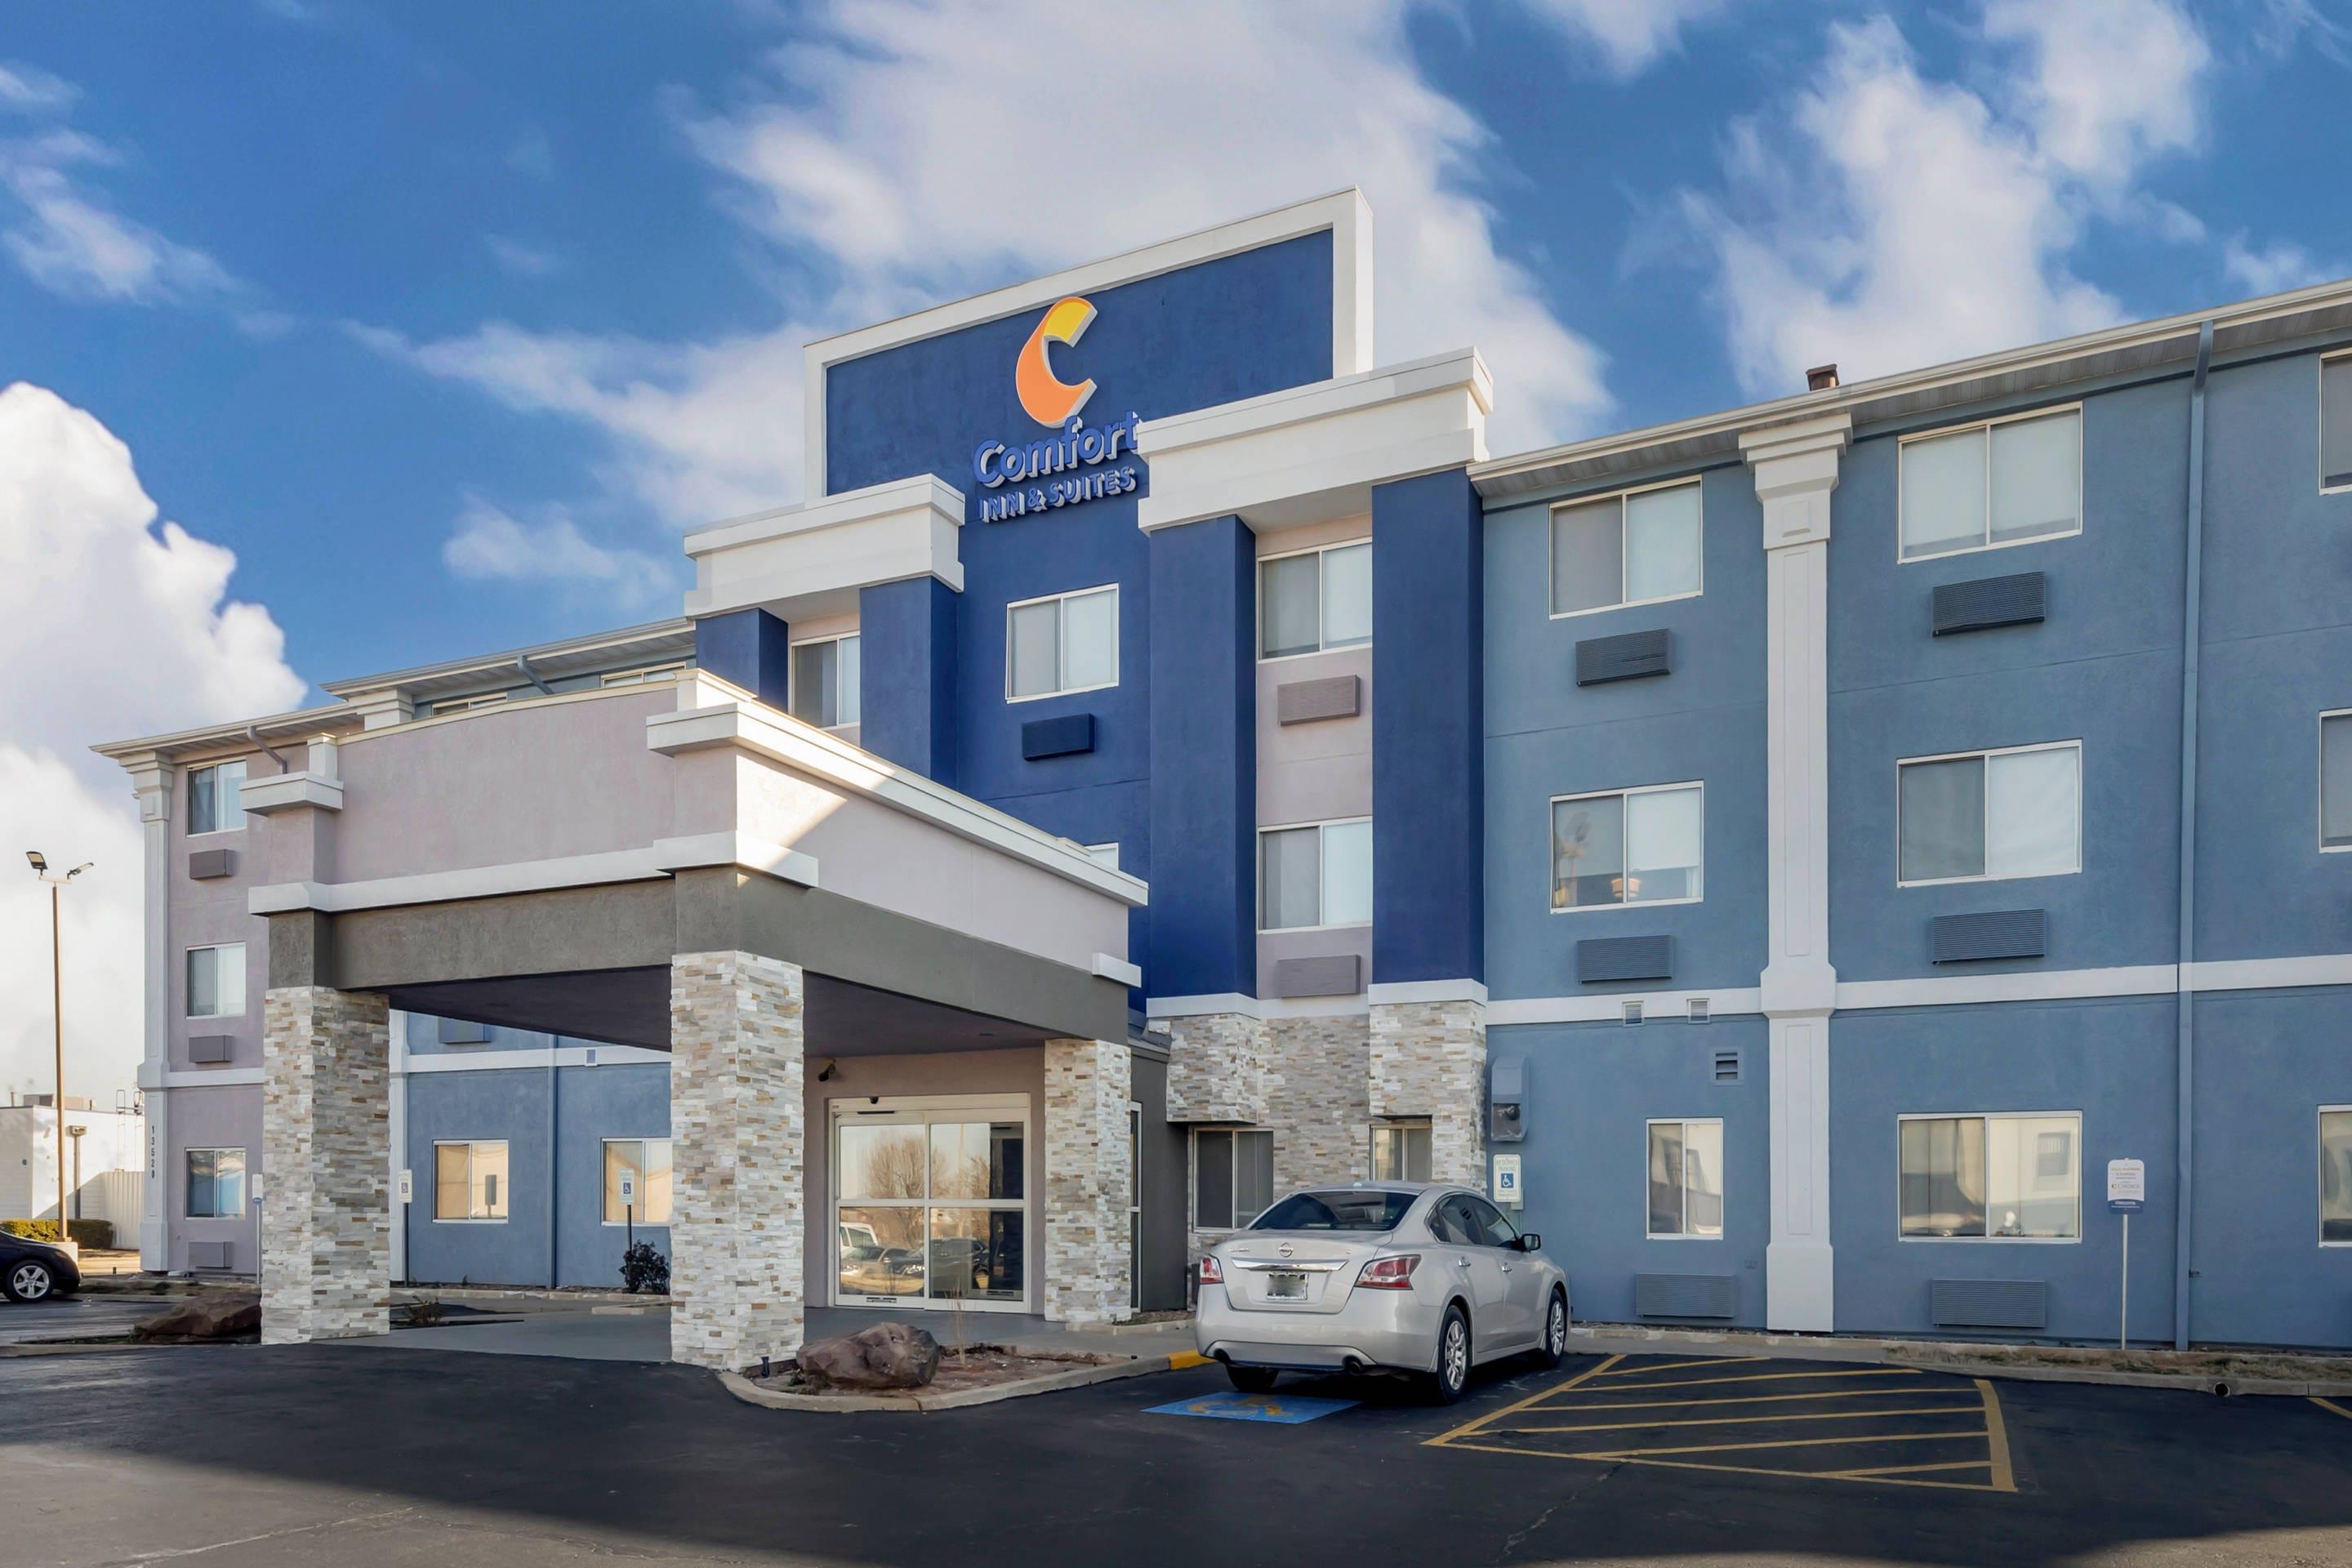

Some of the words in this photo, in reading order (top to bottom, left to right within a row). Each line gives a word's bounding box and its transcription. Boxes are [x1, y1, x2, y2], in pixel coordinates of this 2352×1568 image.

[973, 411, 1143, 488] Comfort
[980, 491, 1025, 523] INN
[1027, 488, 1047, 512] &
[1049, 466, 1136, 506] SUITES
